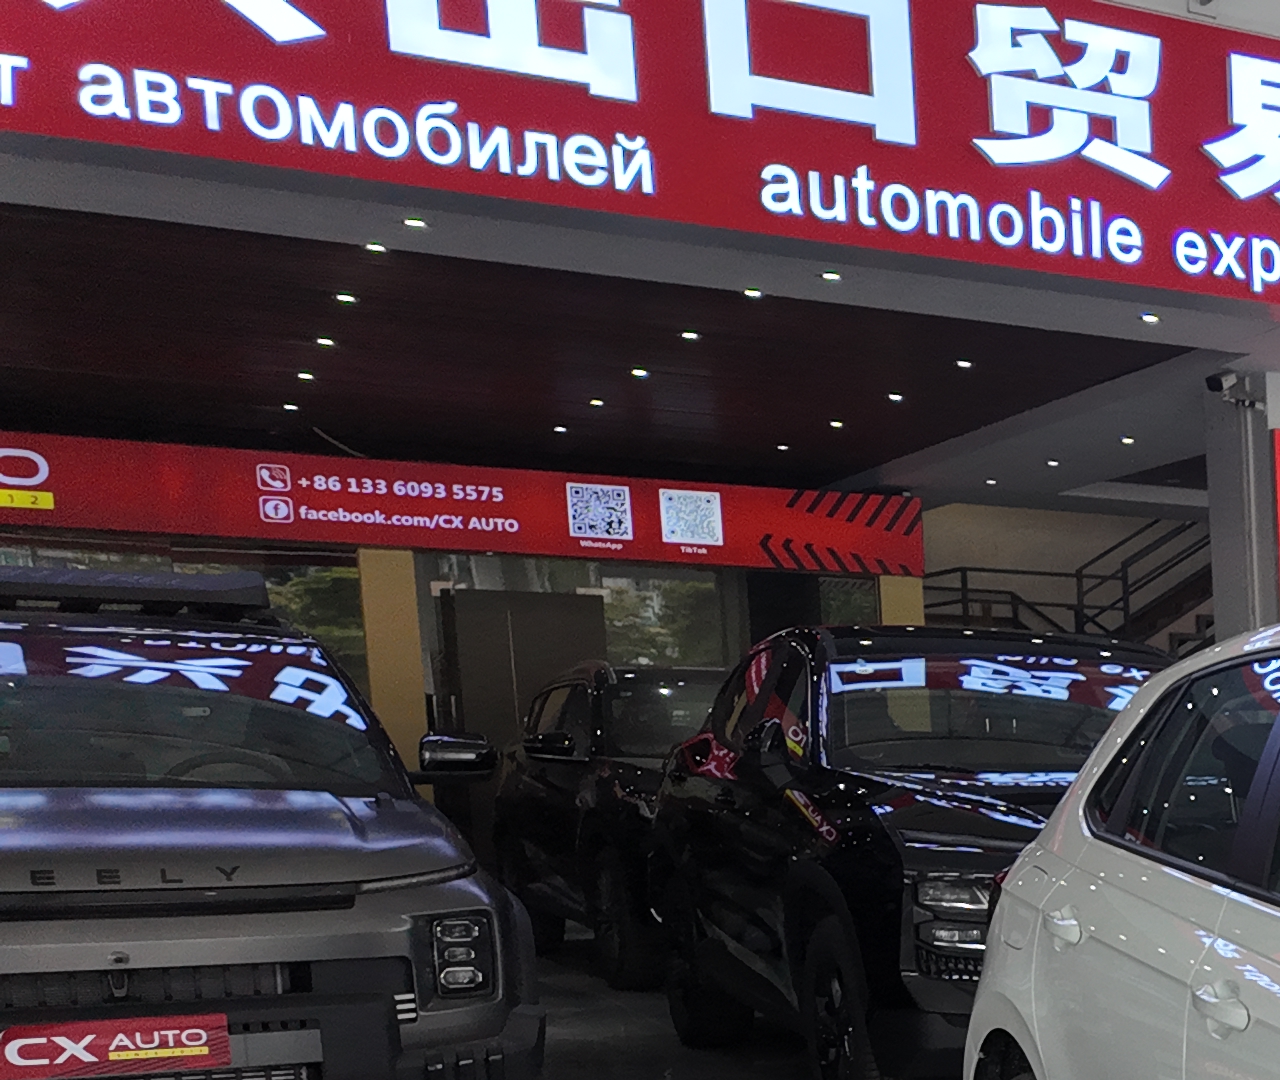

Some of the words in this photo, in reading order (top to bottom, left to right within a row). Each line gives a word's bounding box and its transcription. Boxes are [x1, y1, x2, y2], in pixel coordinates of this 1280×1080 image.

[77, 60, 656, 195] автомобилей
[759, 159, 1144, 265] automobile
[297, 474, 342, 492] +86
[346, 476, 388, 495] 133
[392, 480, 447, 499] 6093
[452, 484, 505, 502] 5575
[298, 504, 464, 530] facebook.com/CX
[467, 516, 519, 533] AUTO
[4, 1034, 100, 1067] CX
[108, 1028, 208, 1051] AUTO
